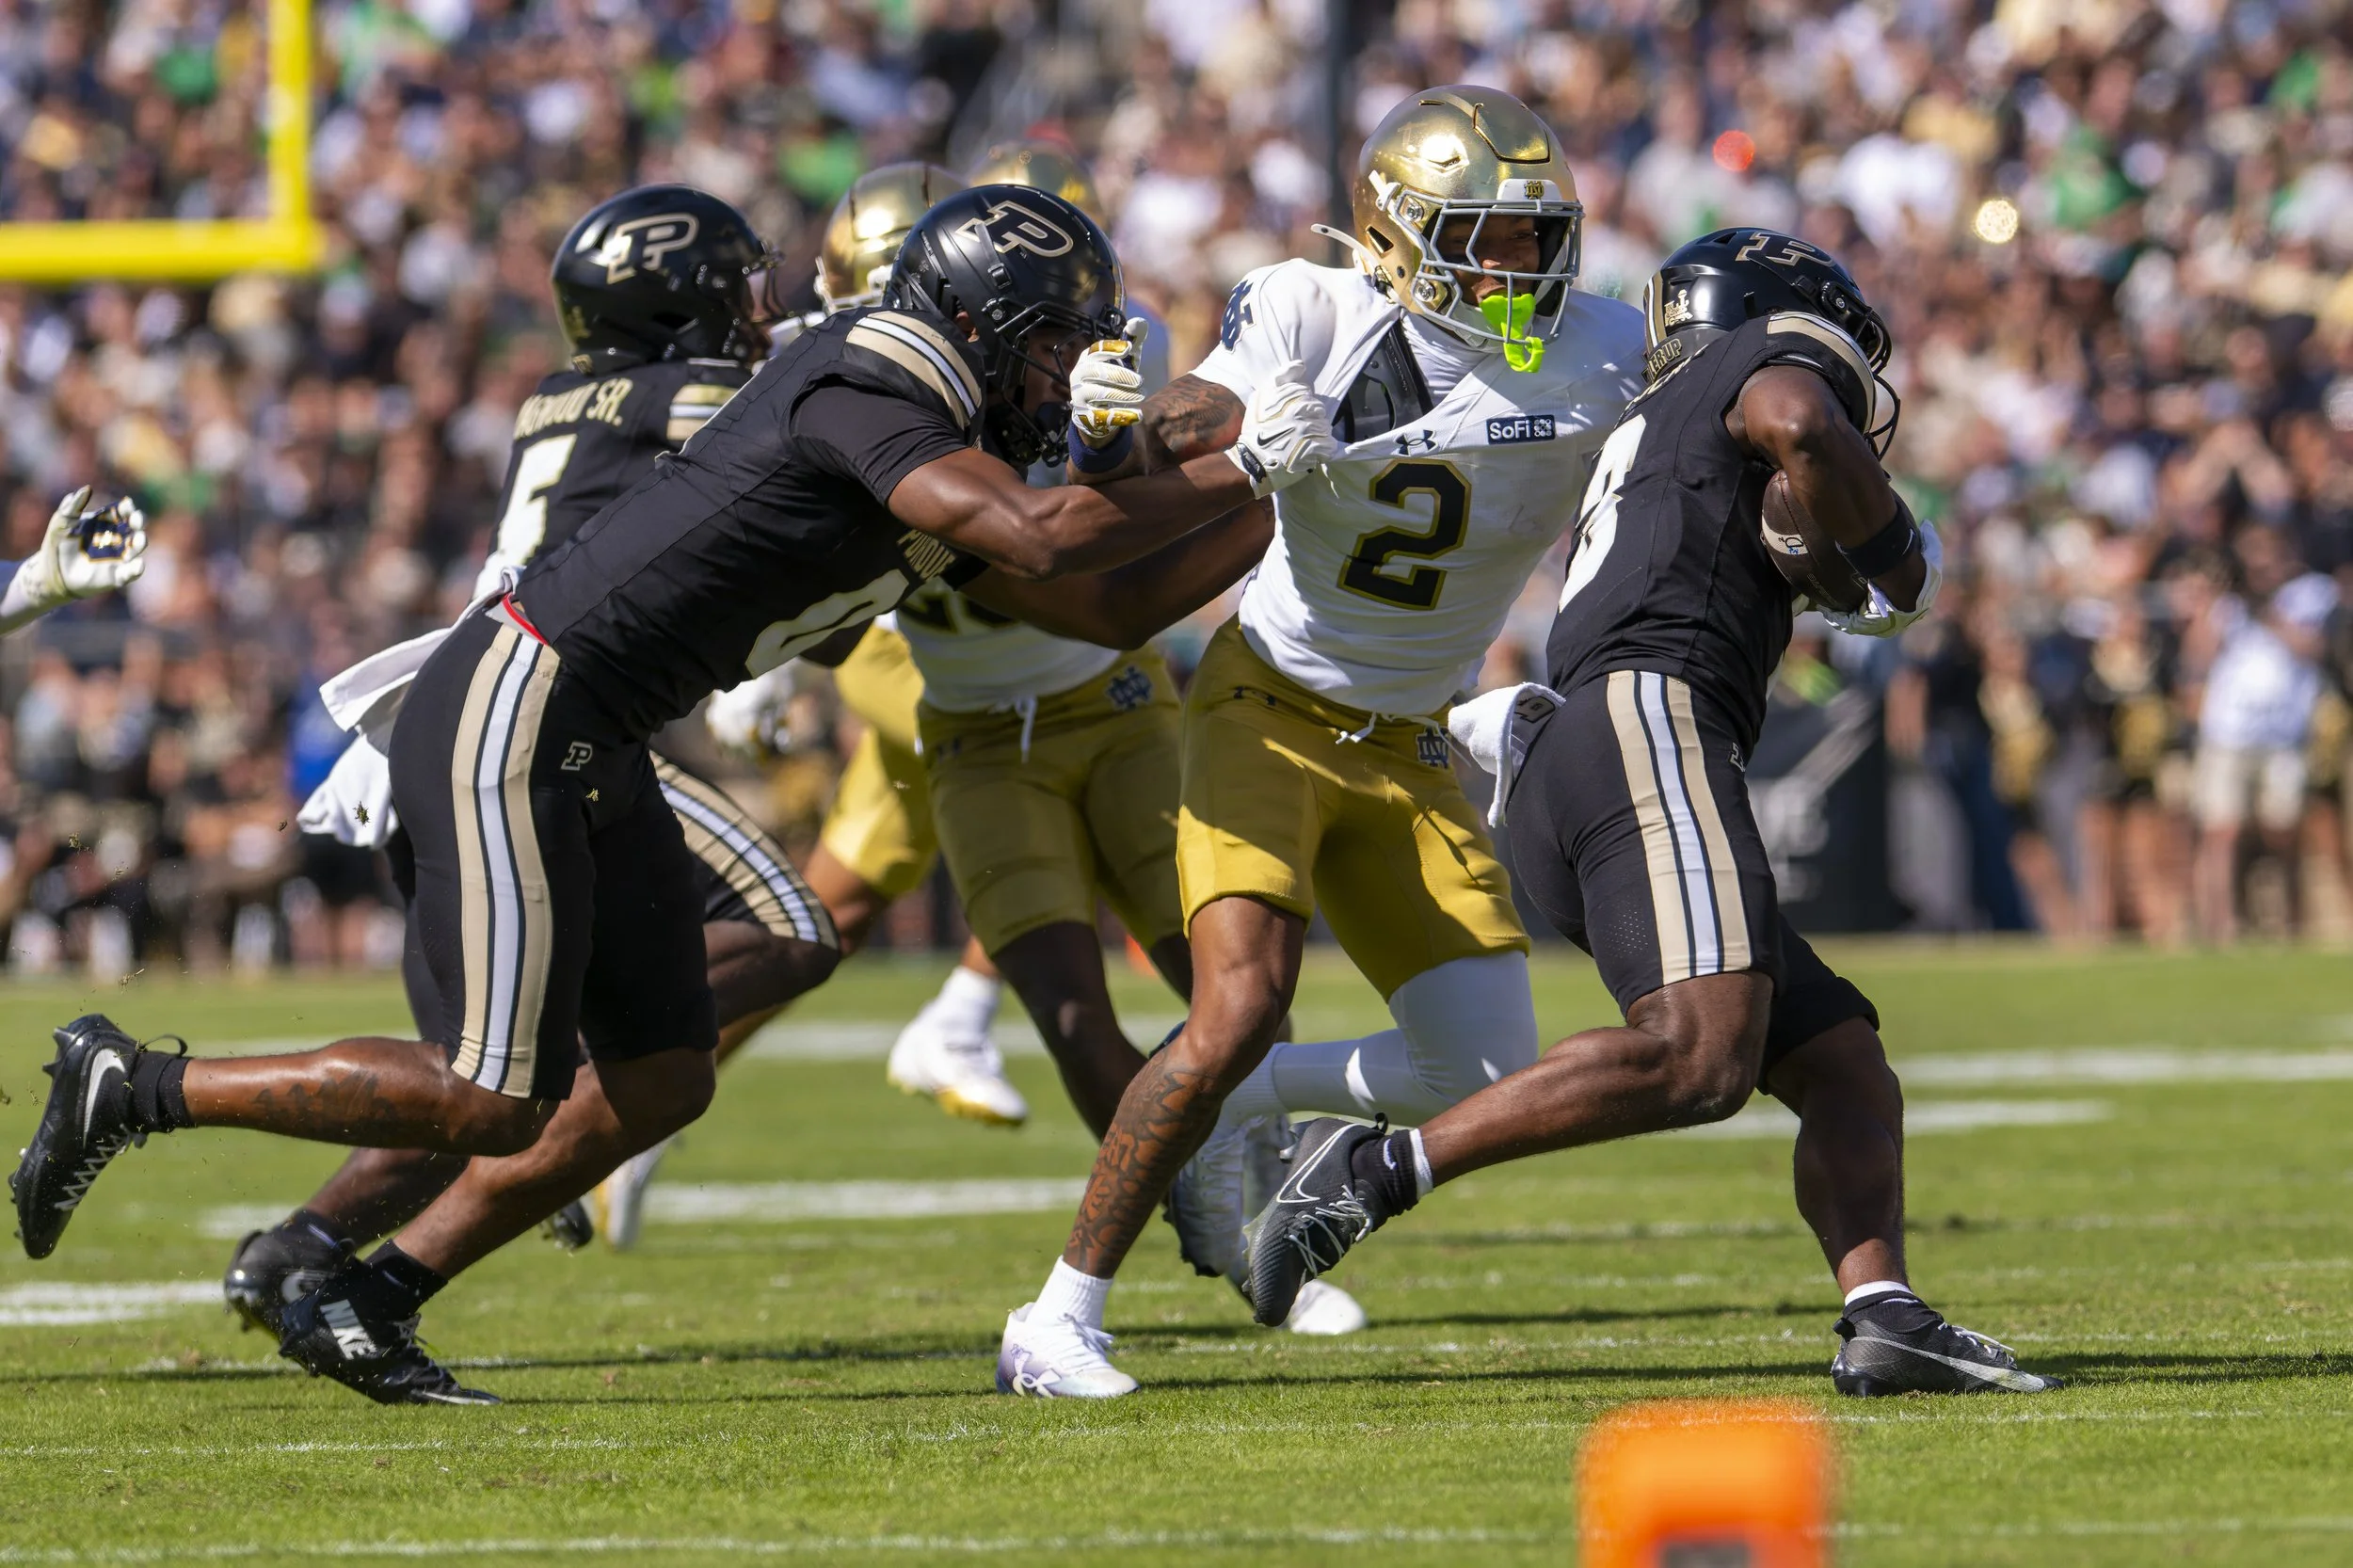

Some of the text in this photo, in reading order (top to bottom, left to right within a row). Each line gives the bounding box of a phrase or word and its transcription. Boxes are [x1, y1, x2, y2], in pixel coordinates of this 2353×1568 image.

[954, 200, 1074, 258] P
[585, 376, 633, 426] SR.
[1489, 419, 1531, 440] SoFi
[896, 529, 957, 584] PURDUE
[1337, 457, 1474, 611] 2
[560, 741, 593, 772] P
[319, 1298, 378, 1361] NIKE
